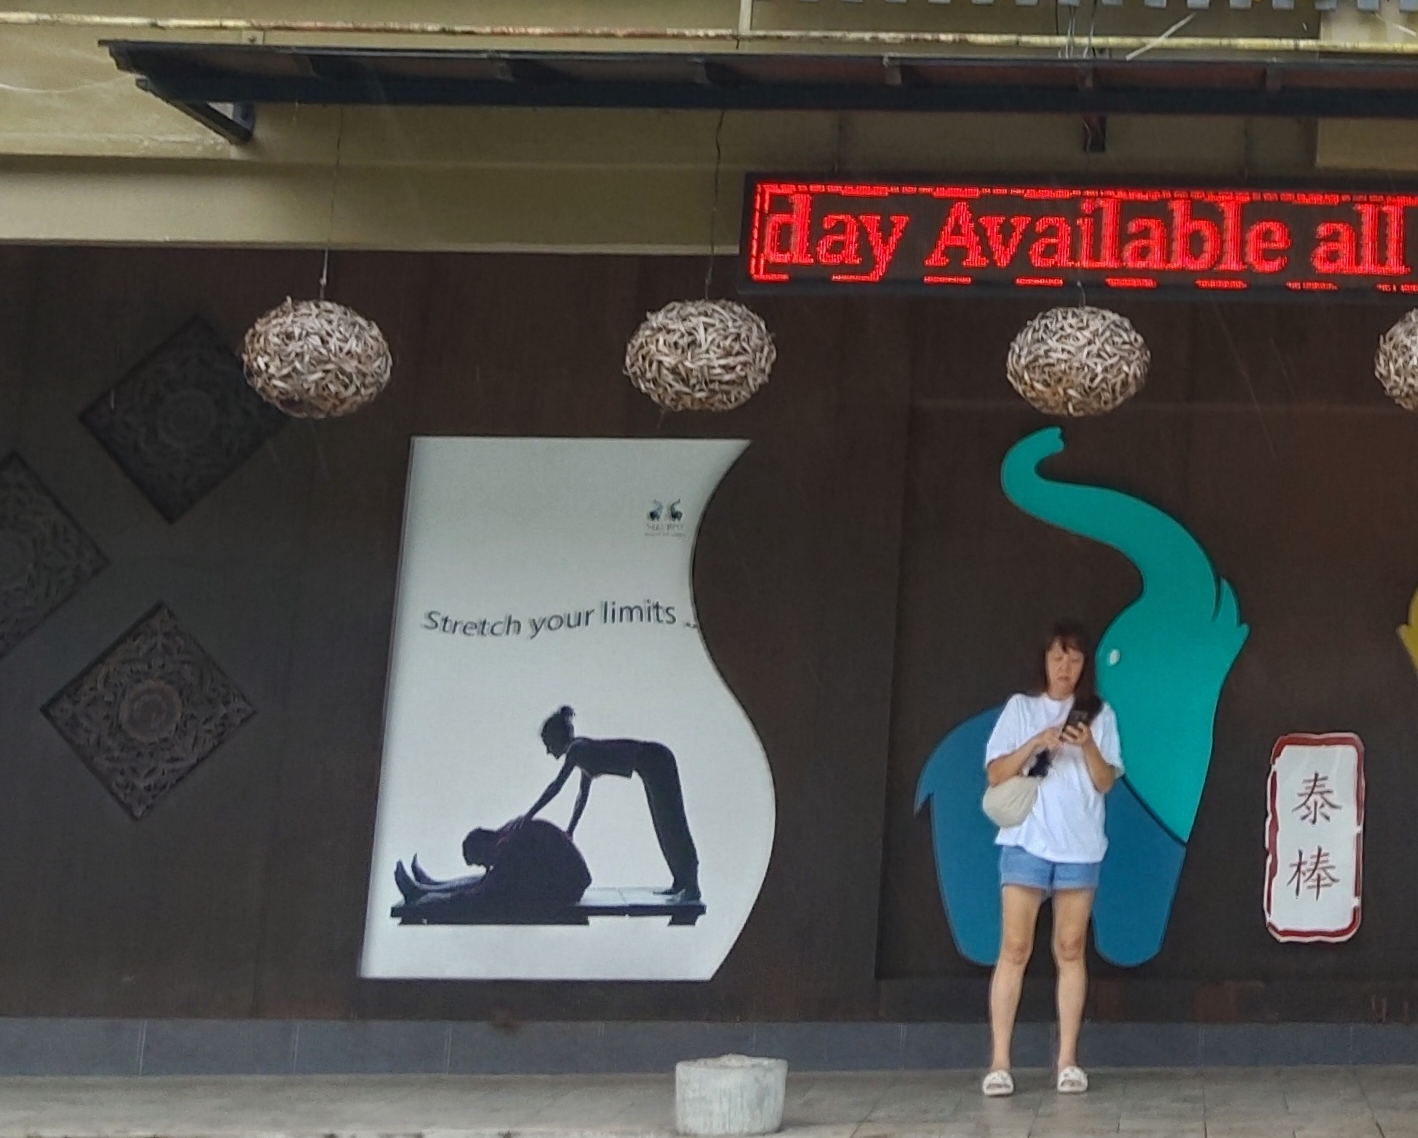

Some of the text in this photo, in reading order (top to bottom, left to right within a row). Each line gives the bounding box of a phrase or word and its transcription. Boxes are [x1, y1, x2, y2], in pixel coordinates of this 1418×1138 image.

[764, 193, 910, 281] day
[923, 199, 1292, 273] Available
[1310, 202, 1412, 275] all
[423, 610, 522, 637] Stretch
[529, 608, 595, 640] your
[1285, 770, 1344, 902] 泰棒
